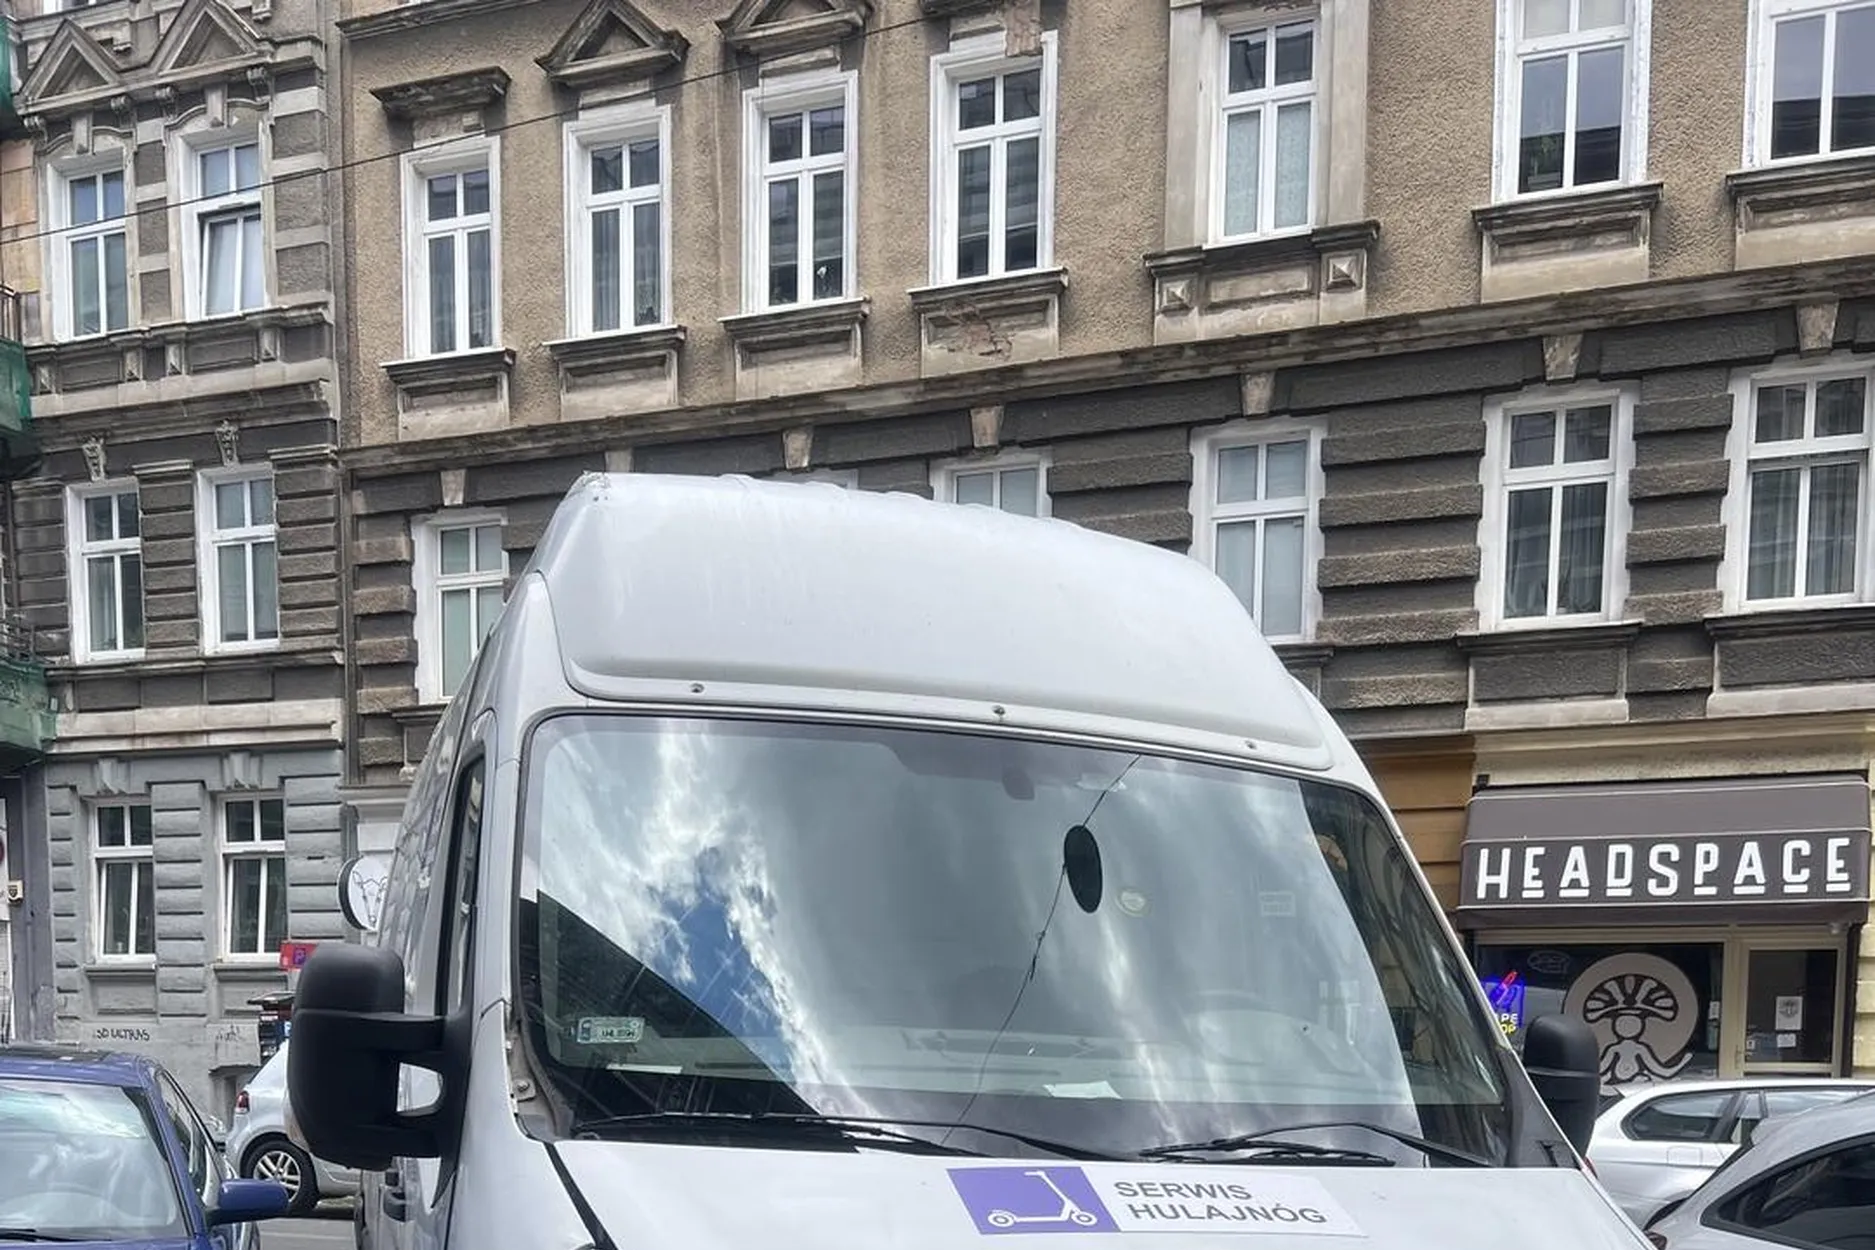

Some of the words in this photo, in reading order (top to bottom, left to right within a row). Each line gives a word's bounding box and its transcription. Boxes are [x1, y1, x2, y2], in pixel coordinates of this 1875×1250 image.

[1476, 838, 1851, 899] HEADSPACE
[1114, 1181, 1252, 1201] SERWIS
[1128, 1203, 1327, 1224] HULAJNÓG
